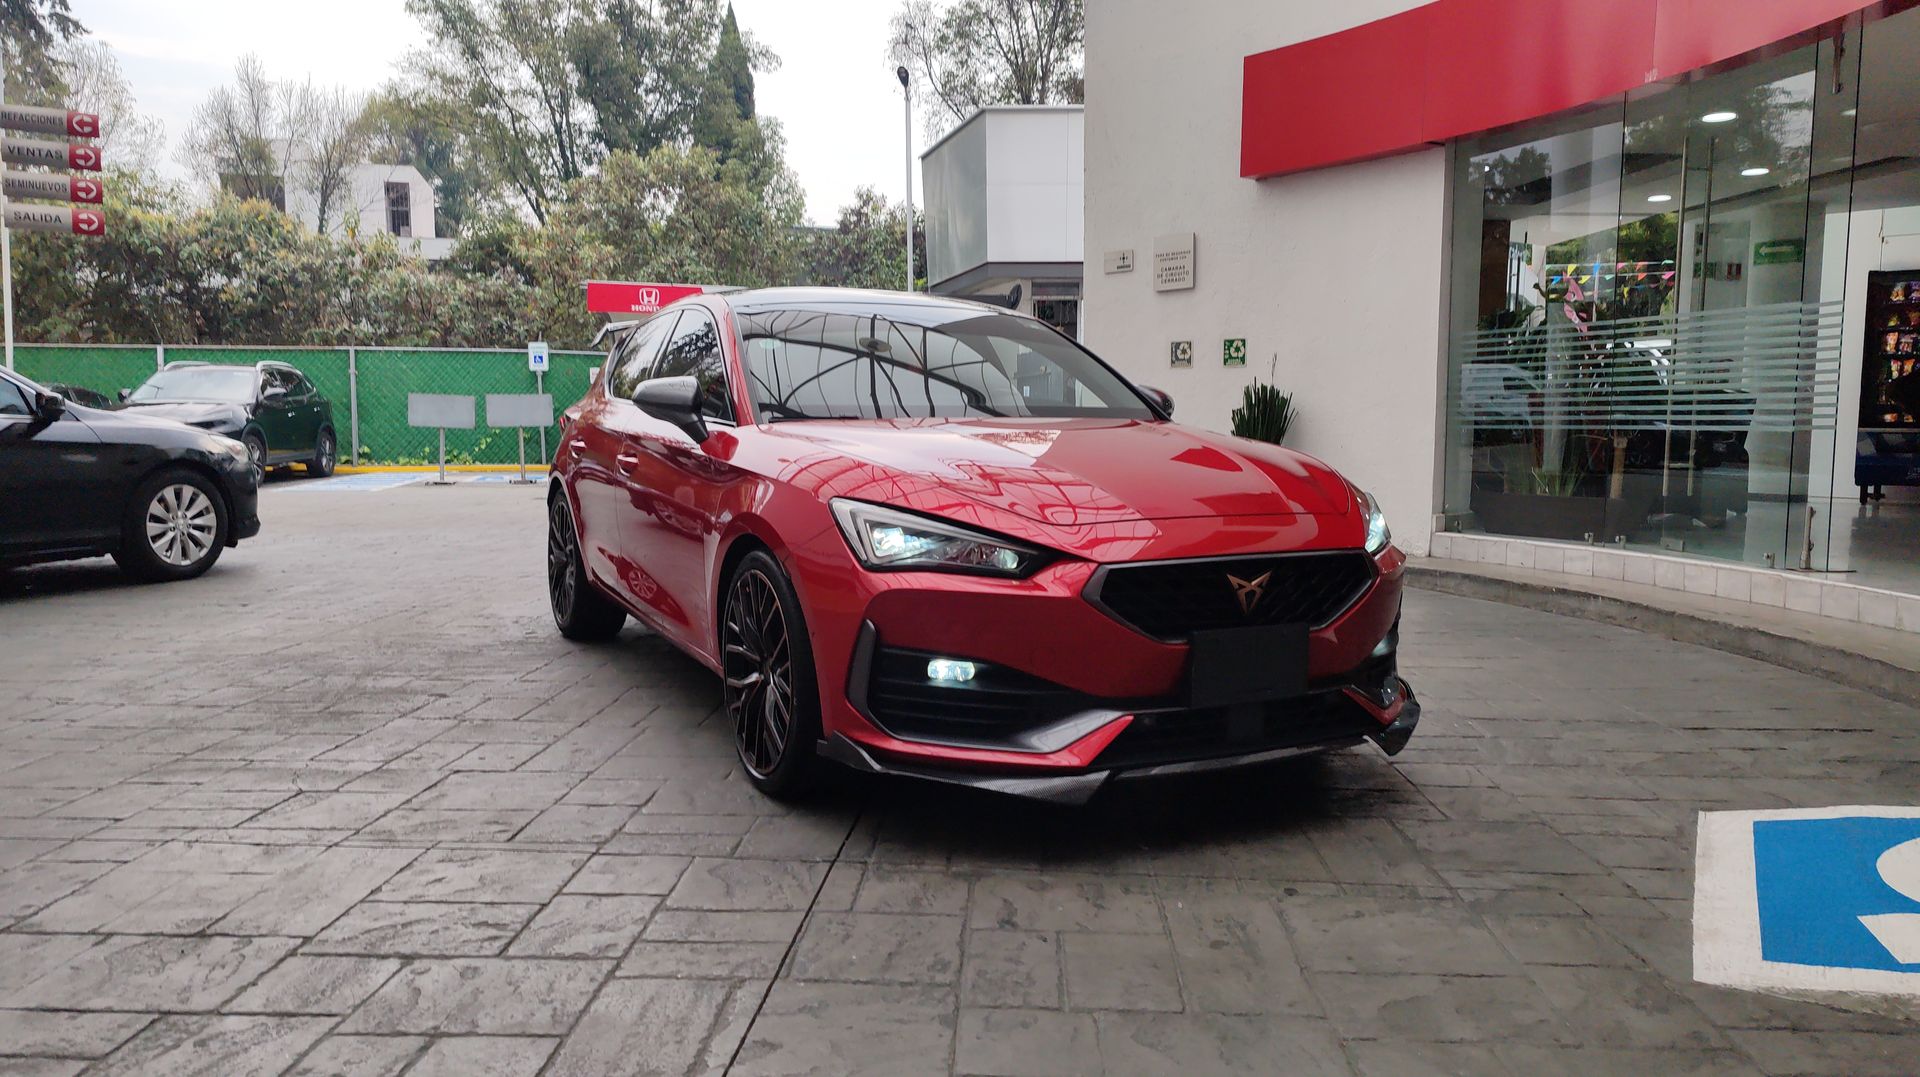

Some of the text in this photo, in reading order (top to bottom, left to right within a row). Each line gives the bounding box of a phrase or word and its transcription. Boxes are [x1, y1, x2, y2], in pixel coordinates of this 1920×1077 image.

[7, 145, 63, 160] VENTAS
[5, 177, 67, 192] SEMINUEVOS
[13, 211, 62, 224] SALIDA
[631, 304, 661, 312] HOND
